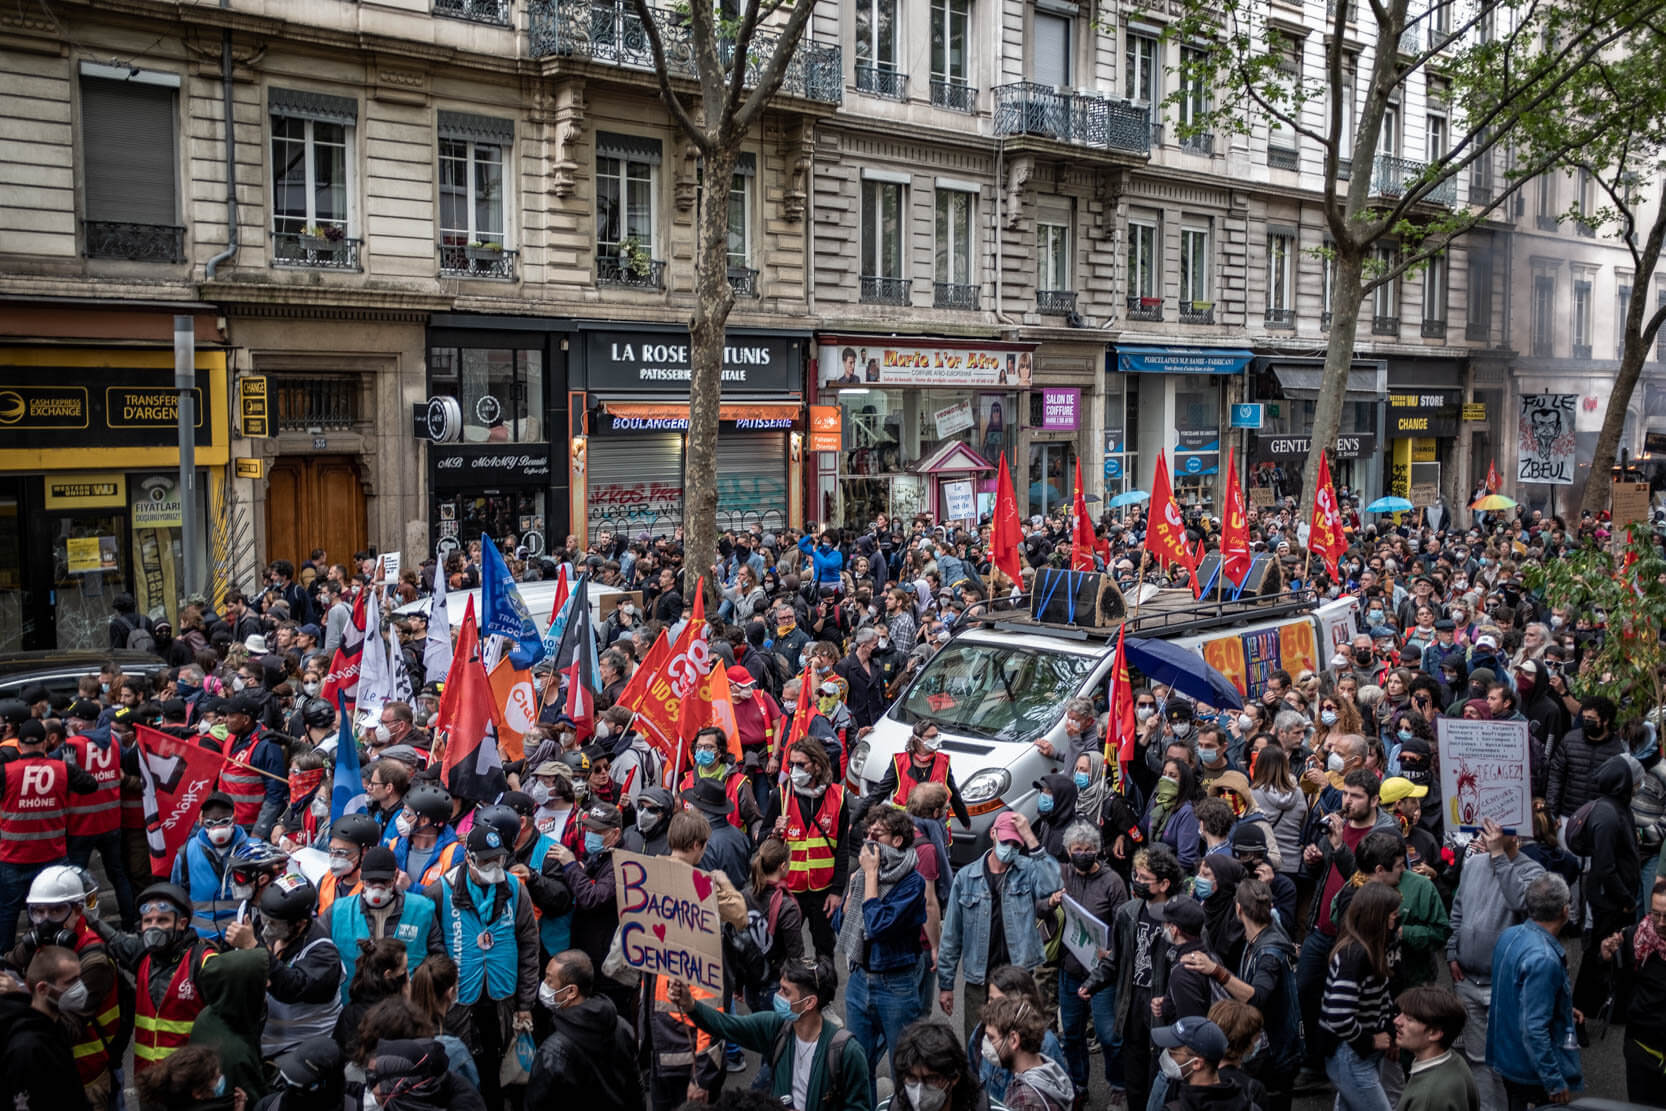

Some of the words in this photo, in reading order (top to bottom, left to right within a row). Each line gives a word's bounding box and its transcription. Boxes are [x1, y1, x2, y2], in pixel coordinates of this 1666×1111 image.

[611, 343, 635, 361] LA
[642, 344, 688, 363] ROSE
[723, 346, 771, 365] TUNIS
[883, 350, 929, 367] Marie
[966, 352, 999, 369] Afro
[639, 368, 692, 382] PATISSERIE
[124, 394, 179, 406] TRANSFER
[1046, 394, 1064, 405] SALON
[1065, 394, 1075, 405] DE
[1420, 395, 1444, 407] STORE
[30, 407, 81, 416] EXCHANGE
[123, 406, 179, 420] D'ARGEN
[1046, 405, 1074, 416] COIFFURE
[612, 417, 689, 431] BOULANGERI
[1398, 418, 1428, 430] CHANGE
[1519, 458, 1572, 482] ZBEUL
[1280, 622, 1310, 658] 60
[1208, 637, 1240, 671] 60
[20, 765, 56, 796] FO
[18, 797, 56, 809] RHÔNE
[619, 860, 715, 935] BAGARRE
[621, 921, 722, 991] GENERALE
